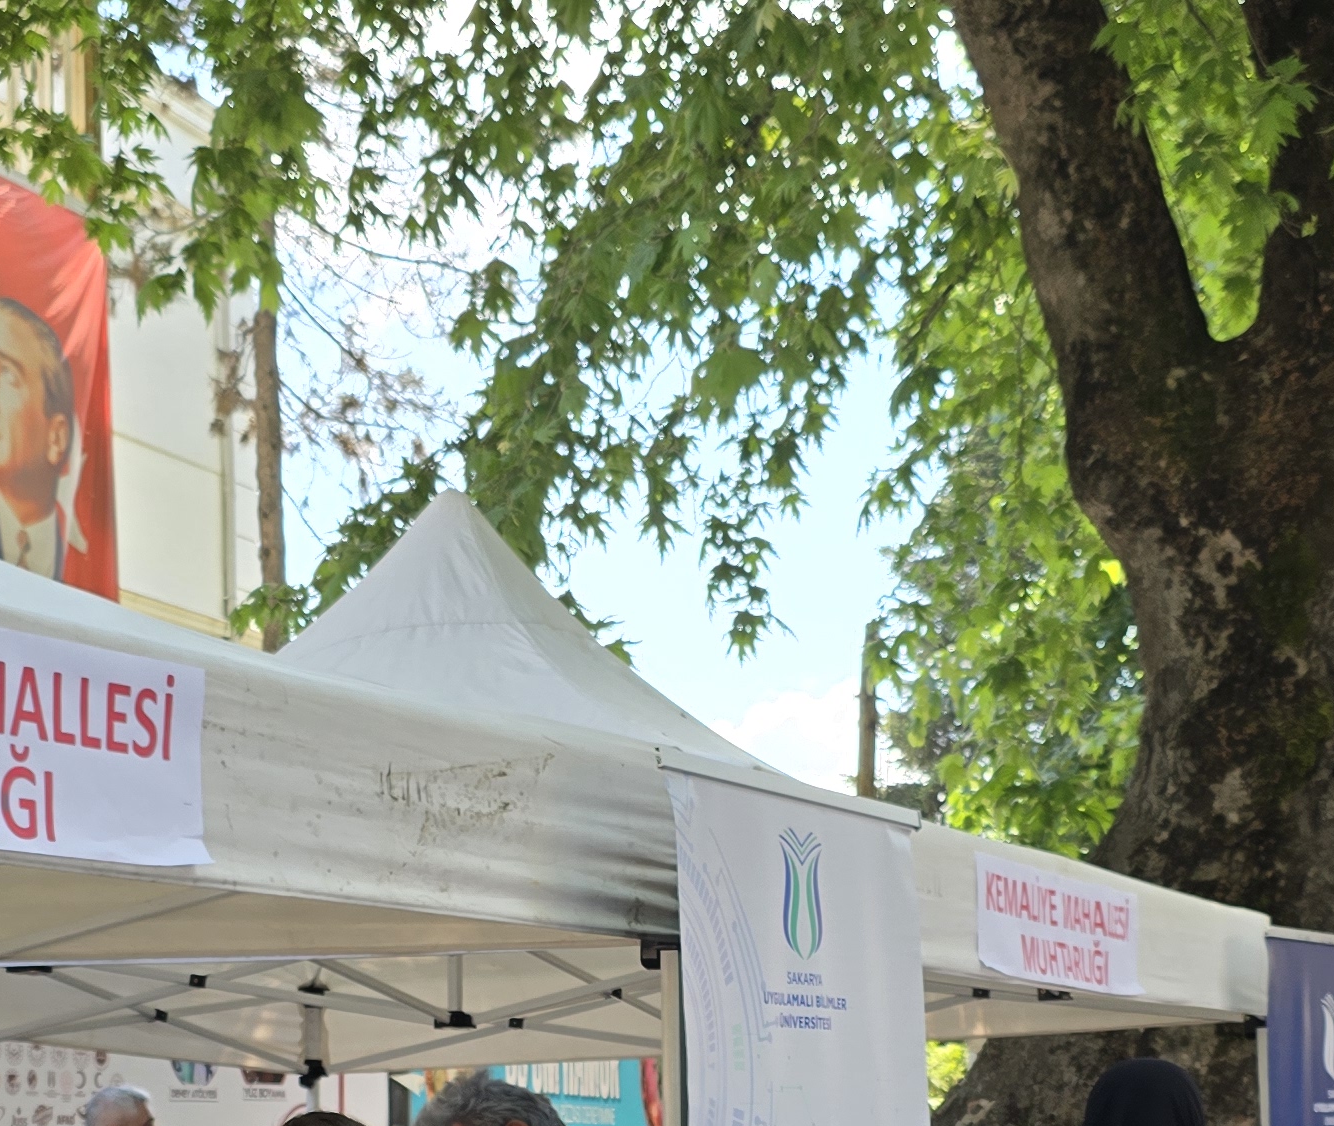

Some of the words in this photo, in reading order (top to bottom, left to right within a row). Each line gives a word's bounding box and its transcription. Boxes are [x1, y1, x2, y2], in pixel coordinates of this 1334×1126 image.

[985, 870, 1058, 926] KEMALİYE
[1020, 934, 1109, 986] MUHTARLIĞI
[787, 971, 822, 986] SAKARYA
[764, 990, 813, 1008] UYGULAMALI
